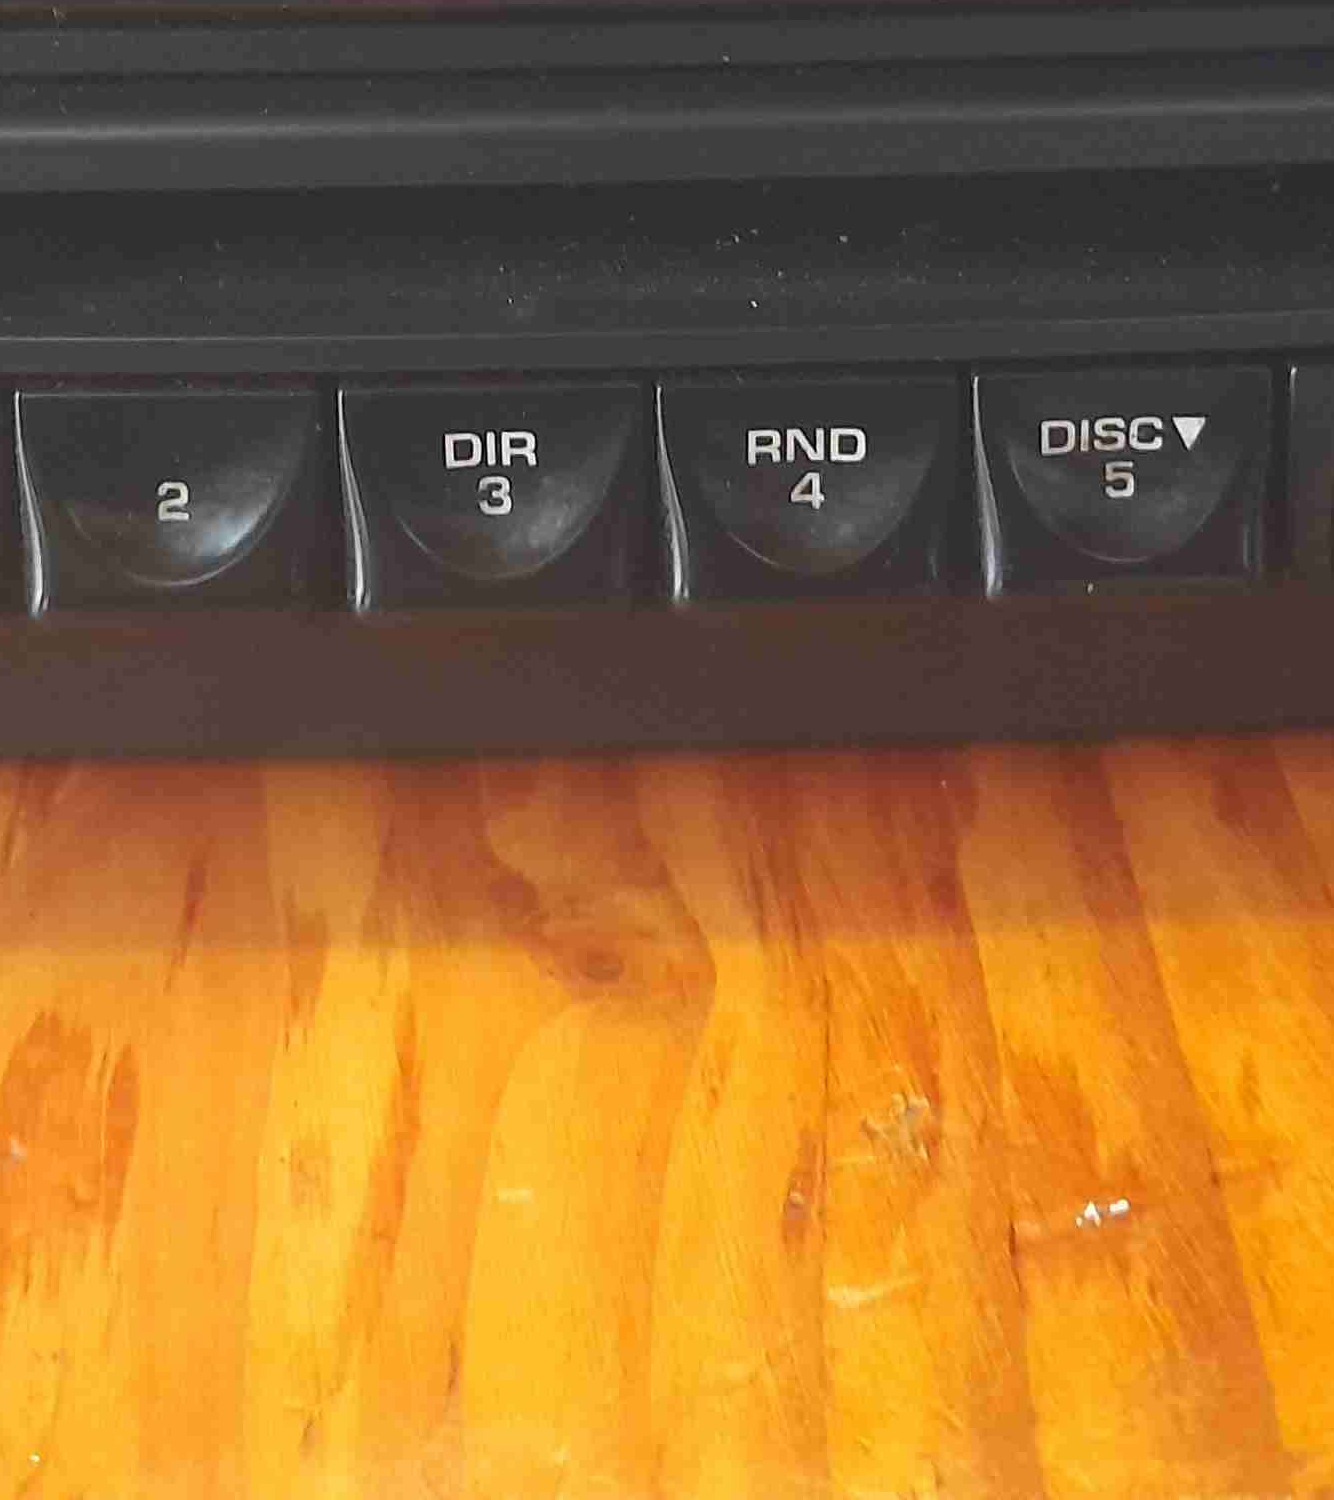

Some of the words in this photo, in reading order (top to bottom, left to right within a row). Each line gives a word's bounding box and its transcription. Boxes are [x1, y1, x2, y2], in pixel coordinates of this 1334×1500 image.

[444, 431, 538, 470] DIR
[746, 427, 868, 466] RND
[1040, 416, 1164, 457] DISC
[478, 475, 513, 516] 3
[790, 471, 826, 510] 4
[1104, 460, 1136, 499] 5
[156, 480, 191, 522] 2
